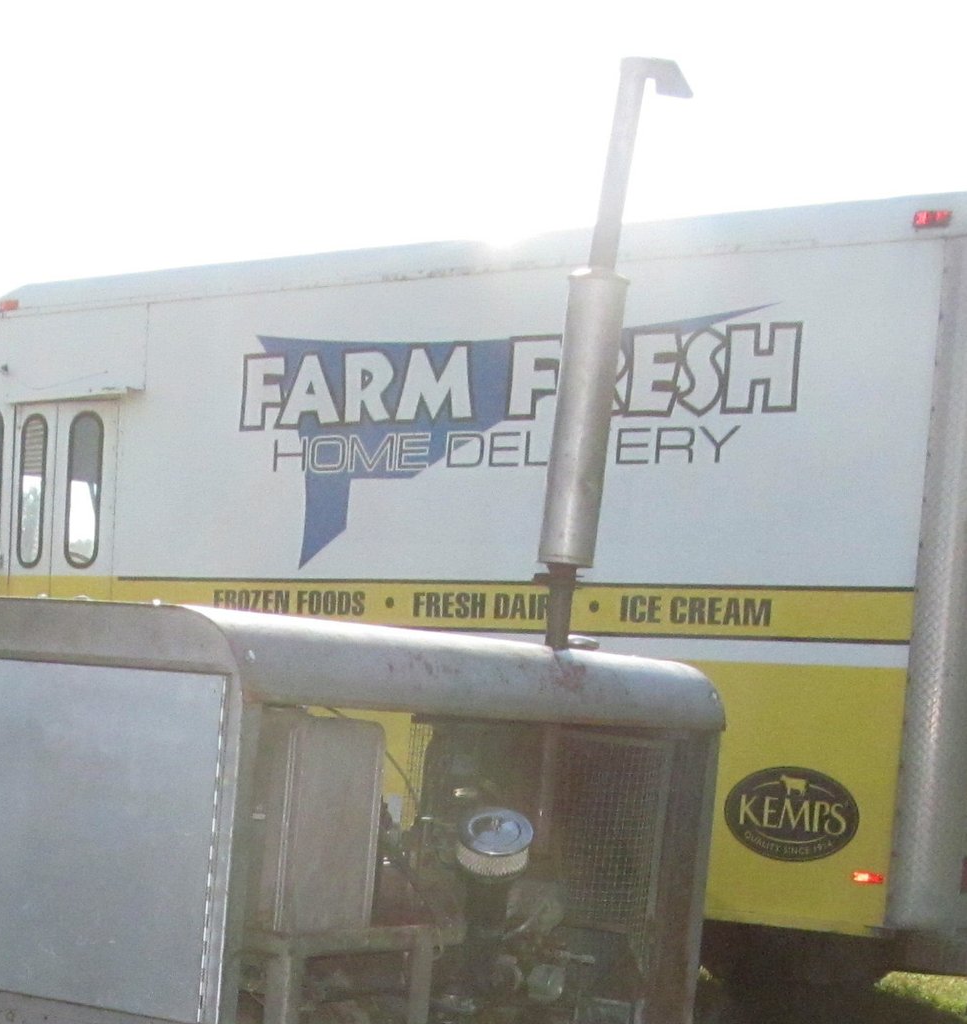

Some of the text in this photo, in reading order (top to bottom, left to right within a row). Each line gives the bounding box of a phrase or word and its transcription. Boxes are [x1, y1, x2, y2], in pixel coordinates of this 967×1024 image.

[239, 341, 474, 431] FARM
[272, 425, 741, 473] HOME DELERY
[213, 588, 773, 627] FROZEN FOODS FRESH DAIR ICE CREAM
[738, 793, 847, 836] KEMPS
